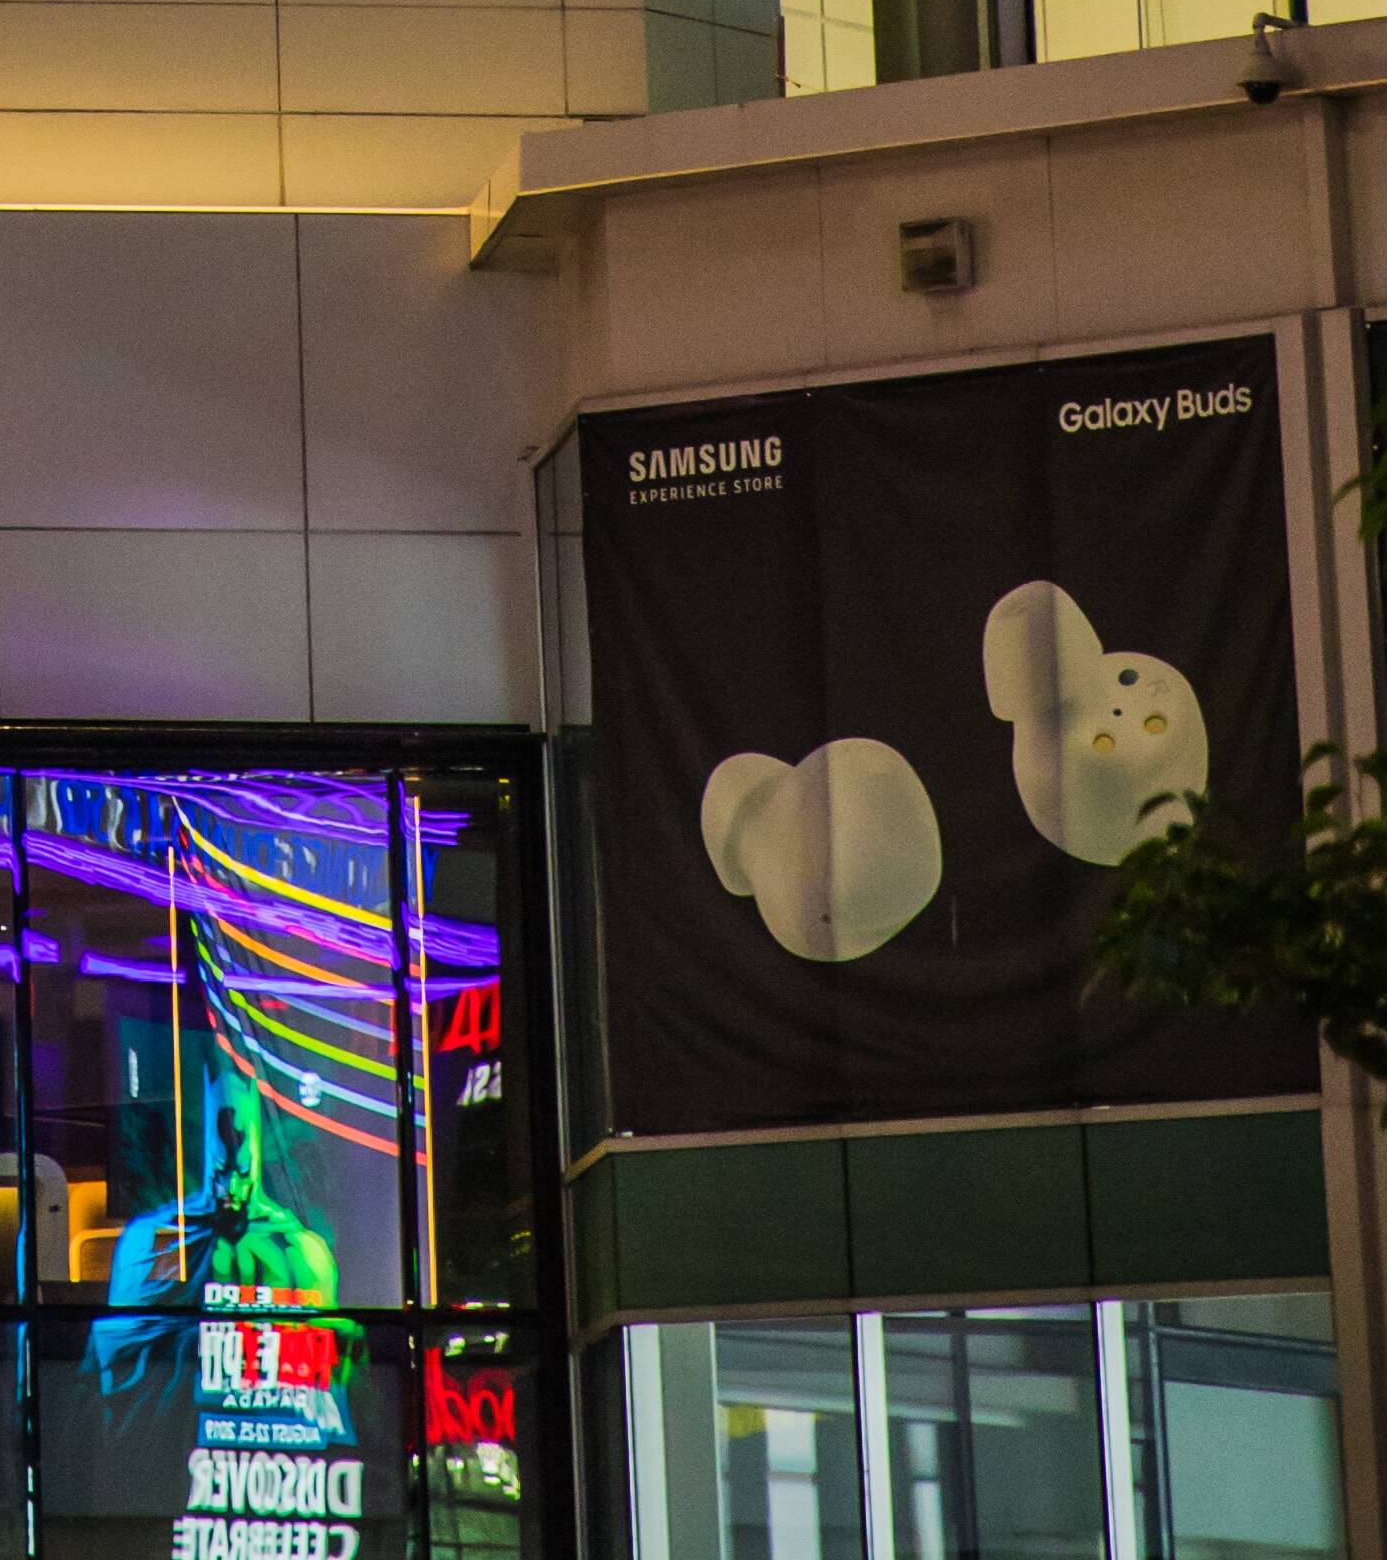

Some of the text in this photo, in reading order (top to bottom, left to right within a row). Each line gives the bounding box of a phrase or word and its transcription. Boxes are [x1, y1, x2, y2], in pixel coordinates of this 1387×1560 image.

[1058, 382, 1253, 434] Galaxy Buds
[628, 435, 783, 483] SAMSUNG
[629, 474, 784, 505] EXPERIENCE STORE
